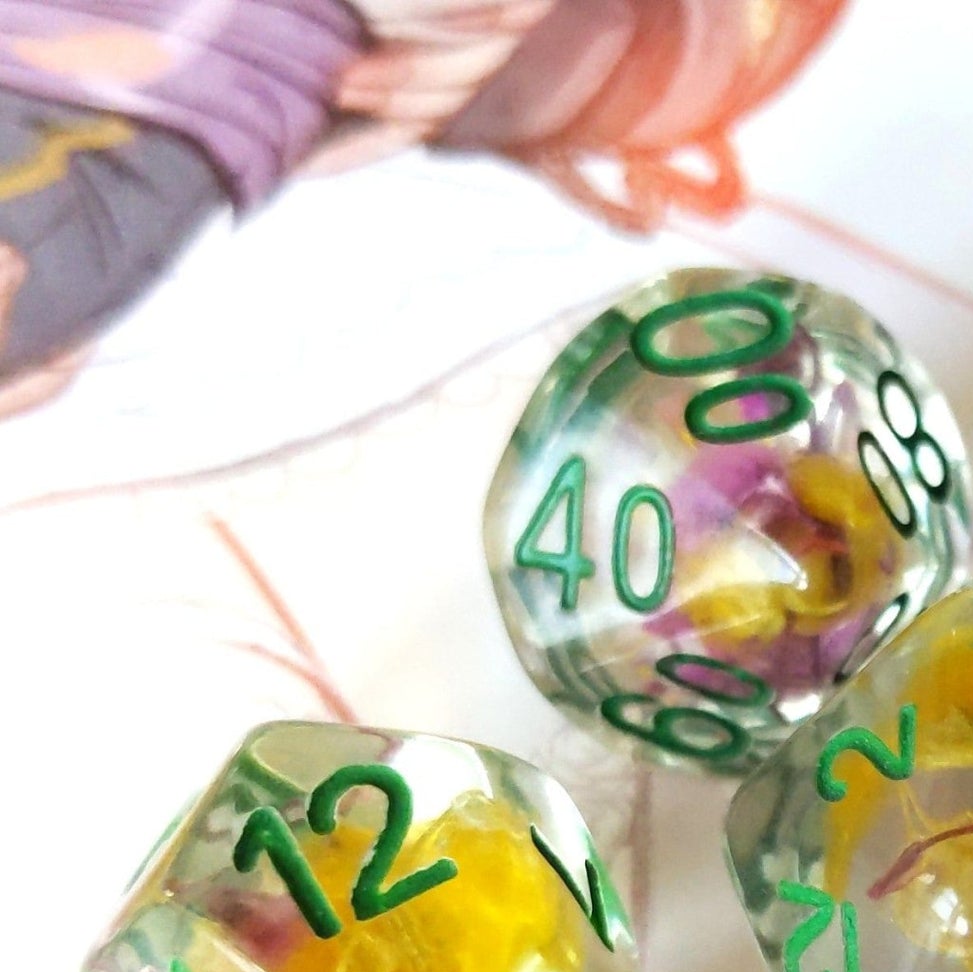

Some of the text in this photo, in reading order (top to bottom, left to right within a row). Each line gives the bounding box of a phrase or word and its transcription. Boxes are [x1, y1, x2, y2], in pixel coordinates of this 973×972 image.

[632, 289, 815, 442] 00
[514, 454, 677, 612] 40
[857, 370, 950, 539] 80
[816, 703, 917, 802] 2
[233, 763, 458, 939] 12
